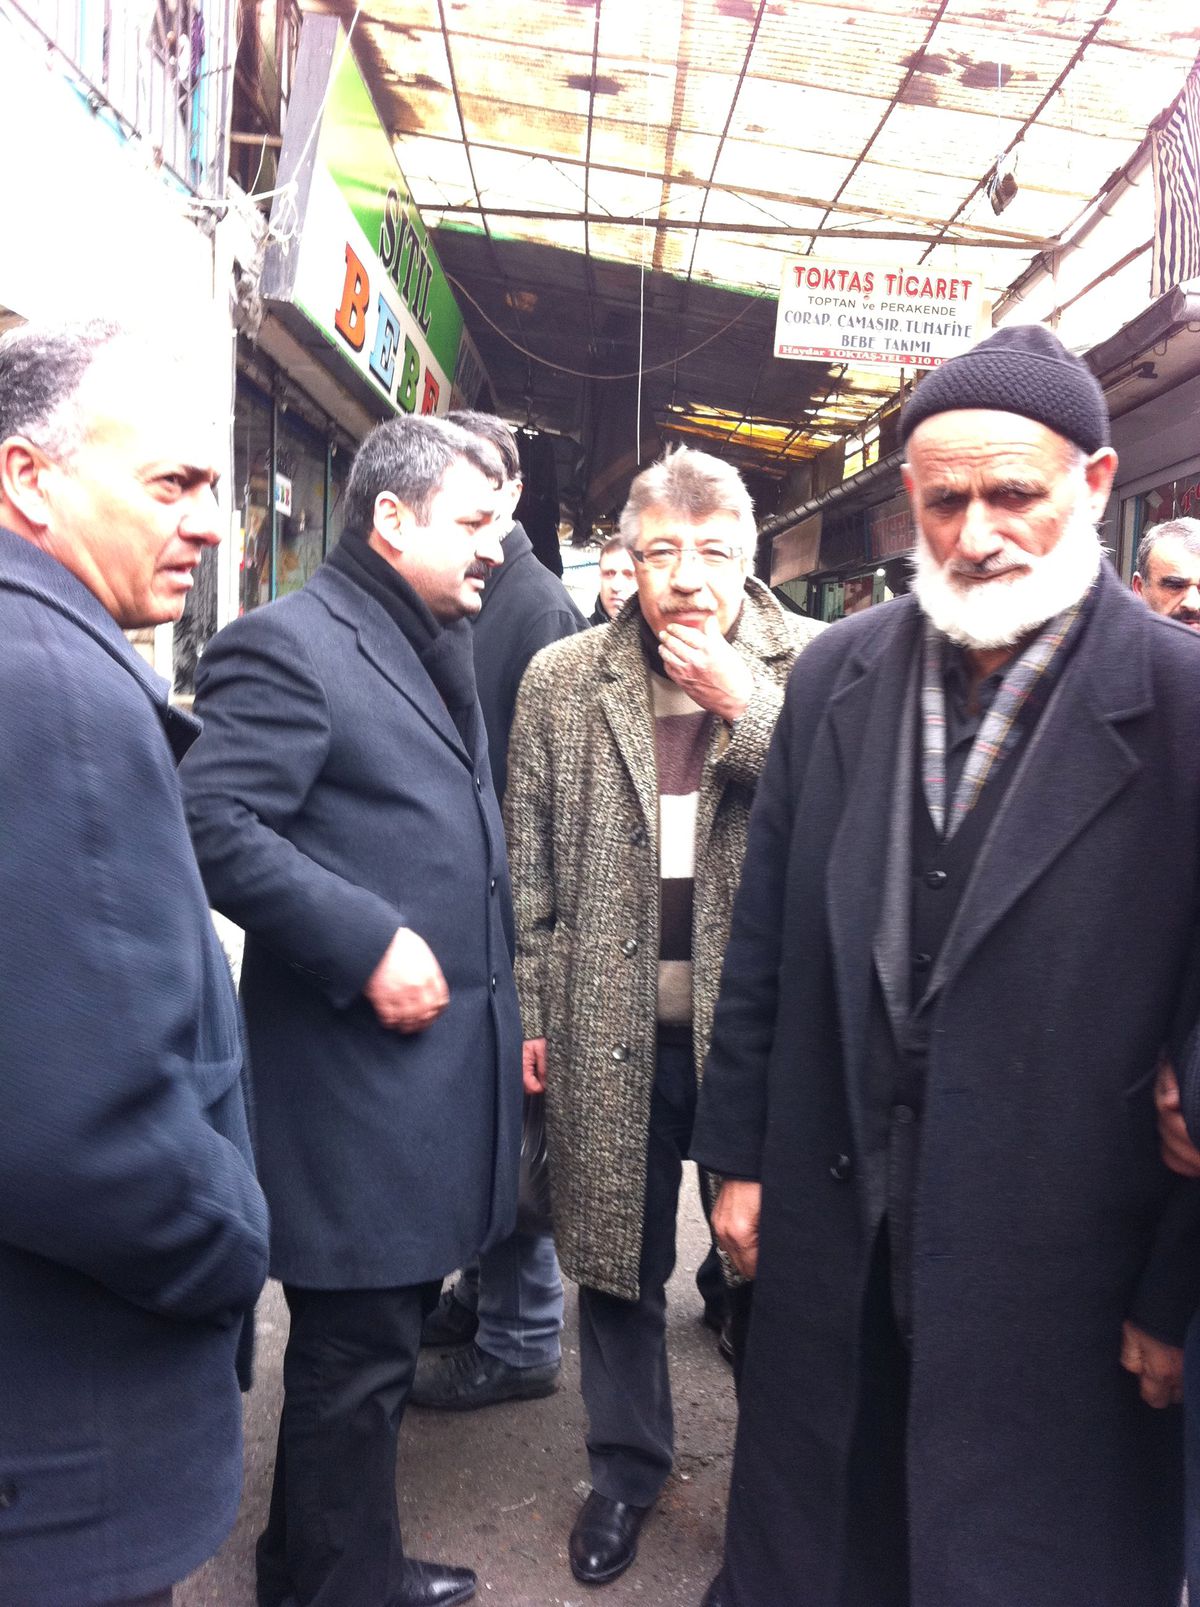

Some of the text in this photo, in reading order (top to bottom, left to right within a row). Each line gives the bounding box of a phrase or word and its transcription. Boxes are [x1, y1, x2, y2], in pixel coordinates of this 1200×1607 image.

[793, 266, 972, 301] TOKTAŞ TİCARET
[808, 296, 956, 316] TOPTAN ve PERAKENDE
[906, 320, 972, 338] TUHAFİYE
[841, 335, 931, 353] BEBE TAKIMI
[782, 345, 826, 357] Haydar
[909, 356, 932, 365] 310
